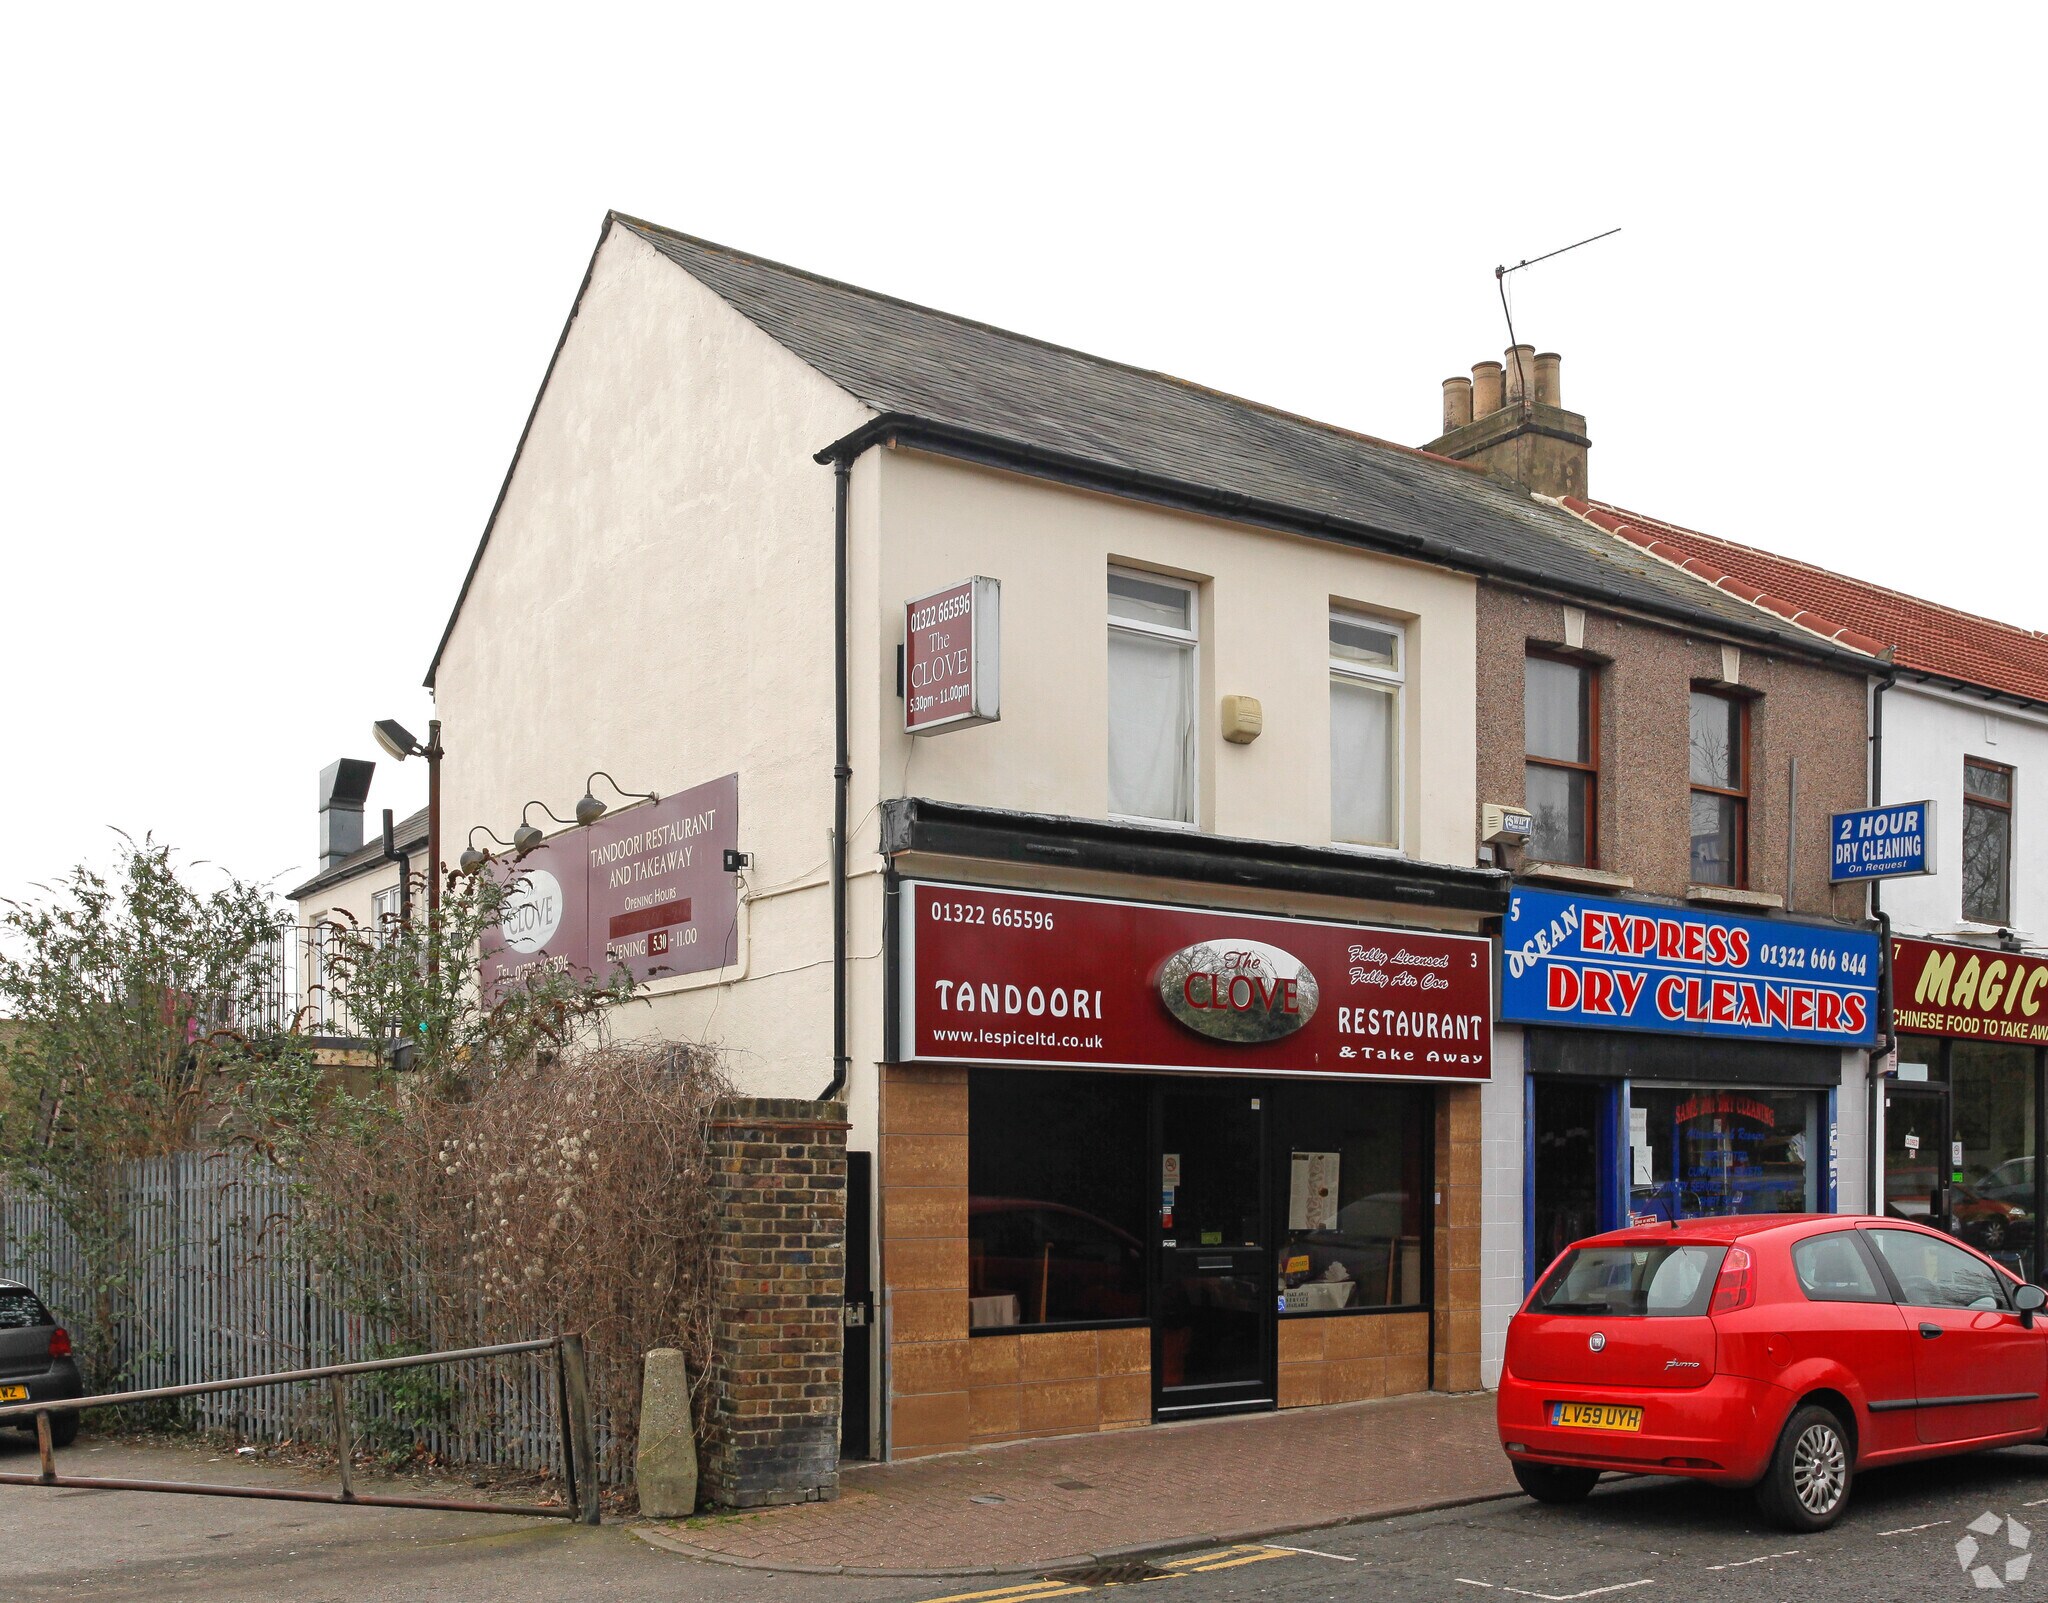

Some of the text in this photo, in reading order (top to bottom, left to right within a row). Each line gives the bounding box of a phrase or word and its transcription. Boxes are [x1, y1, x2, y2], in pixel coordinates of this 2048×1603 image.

[911, 592, 970, 632] 01322 665596
[928, 631, 950, 652] The
[912, 648, 968, 688] CLOVE
[910, 694, 934, 713] 5.30pm
[940, 683, 970, 704] 11.00pm
[1508, 815, 1530, 828] SWIFT
[1840, 811, 1918, 840] 2 HOUR
[590, 810, 716, 868] TANDOORI RESTAURANT
[1836, 835, 1921, 864] DRY CLEANING
[609, 846, 693, 889] AND TAKEAWAY
[1848, 860, 1907, 873] On Request
[509, 896, 552, 934] CLOVE
[931, 902, 1054, 930] 01322 665596
[1510, 898, 1520, 922] 5
[607, 940, 646, 962] EVENING
[676, 928, 697, 947] 11.00
[1348, 944, 1449, 967] Fully Licensed
[1509, 904, 1578, 978] OCEAN
[1580, 908, 1866, 976] EXPRESS 01322 666 844
[1894, 944, 1901, 960] 7
[1224, 950, 1260, 970] The
[1471, 953, 1477, 968] 3
[1184, 972, 1300, 1014] CLOVE
[1348, 967, 1449, 990] Fully Air Con
[1914, 949, 2048, 1016] MAGIC
[935, 979, 1102, 1019] TANDOORI
[1546, 963, 1866, 1034] DRY CLEANERS
[933, 1028, 1102, 1048] www.lespiceltd.co.uk
[1338, 1007, 1482, 1040] RESTAURANT
[1894, 1008, 1944, 1030] CHINESE
[1946, 1015, 1980, 1033] FOOD
[1983, 1019, 1998, 1035] TO
[2000, 1021, 2028, 1038] TAKE
[1426, 1051, 1483, 1064] Away
[1676, 1095, 1698, 1124] SAME
[1736, 1098, 1775, 1127] CLEANING
[1562, 1406, 1639, 1427] LV59 UYH
